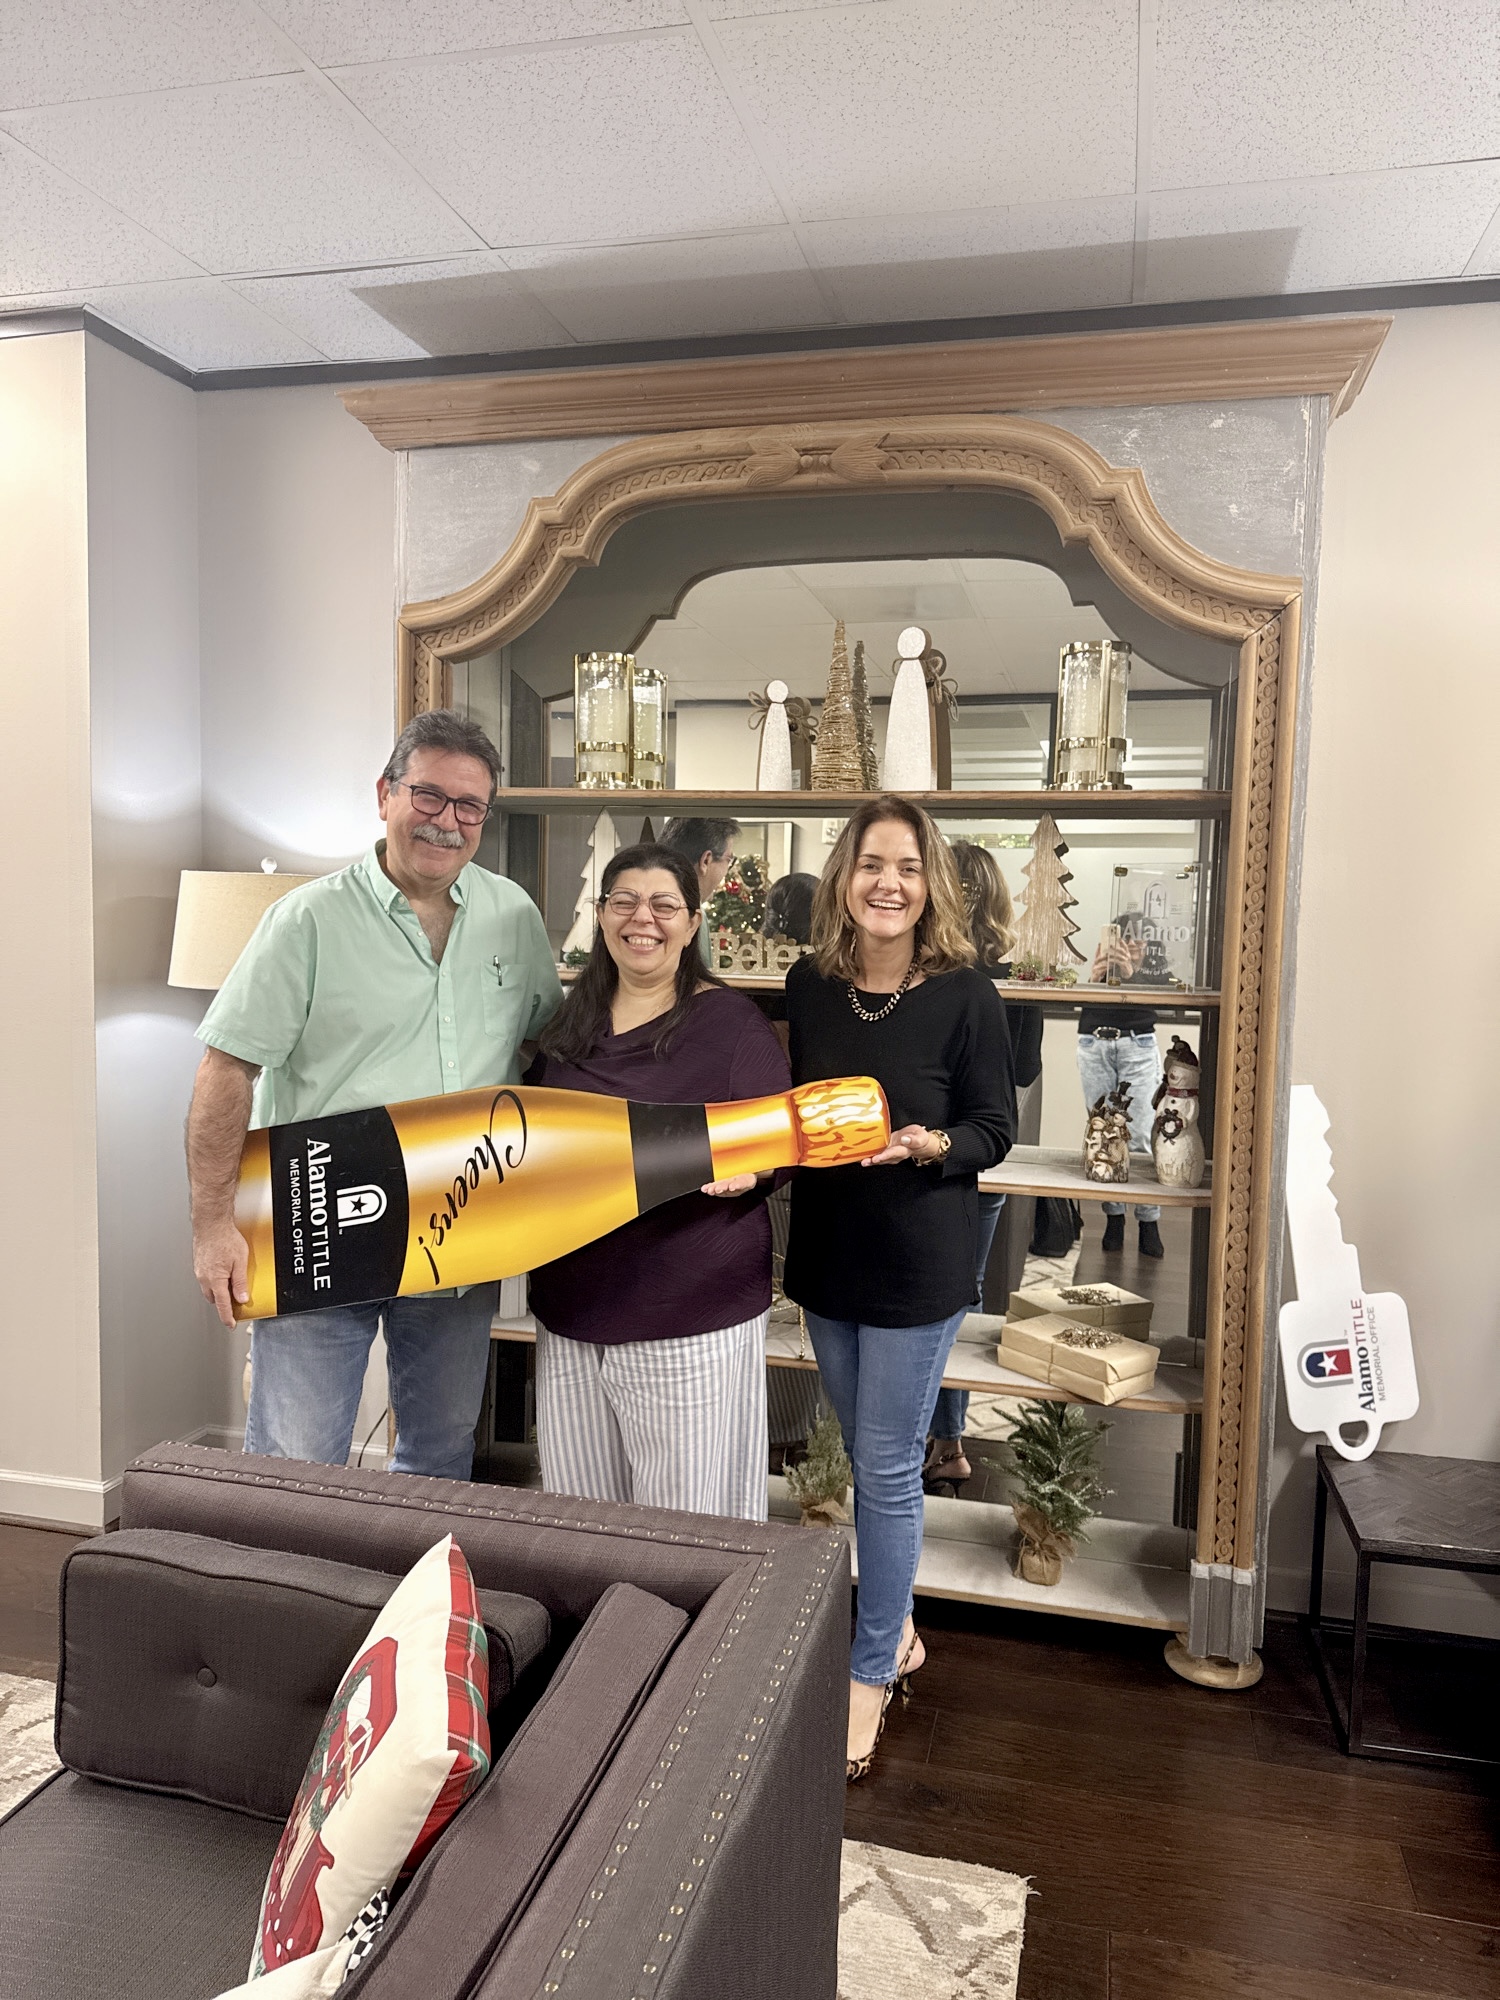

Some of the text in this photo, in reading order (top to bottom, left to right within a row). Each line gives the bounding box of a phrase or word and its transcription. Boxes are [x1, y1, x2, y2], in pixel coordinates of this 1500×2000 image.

[1122, 920, 1191, 942] Alamo
[289, 1158, 305, 1275] MEMORIAL OFFICE
[417, 1089, 528, 1286] Cheers!
[1367, 1306, 1386, 1402] MEMORIAL OFFICE
